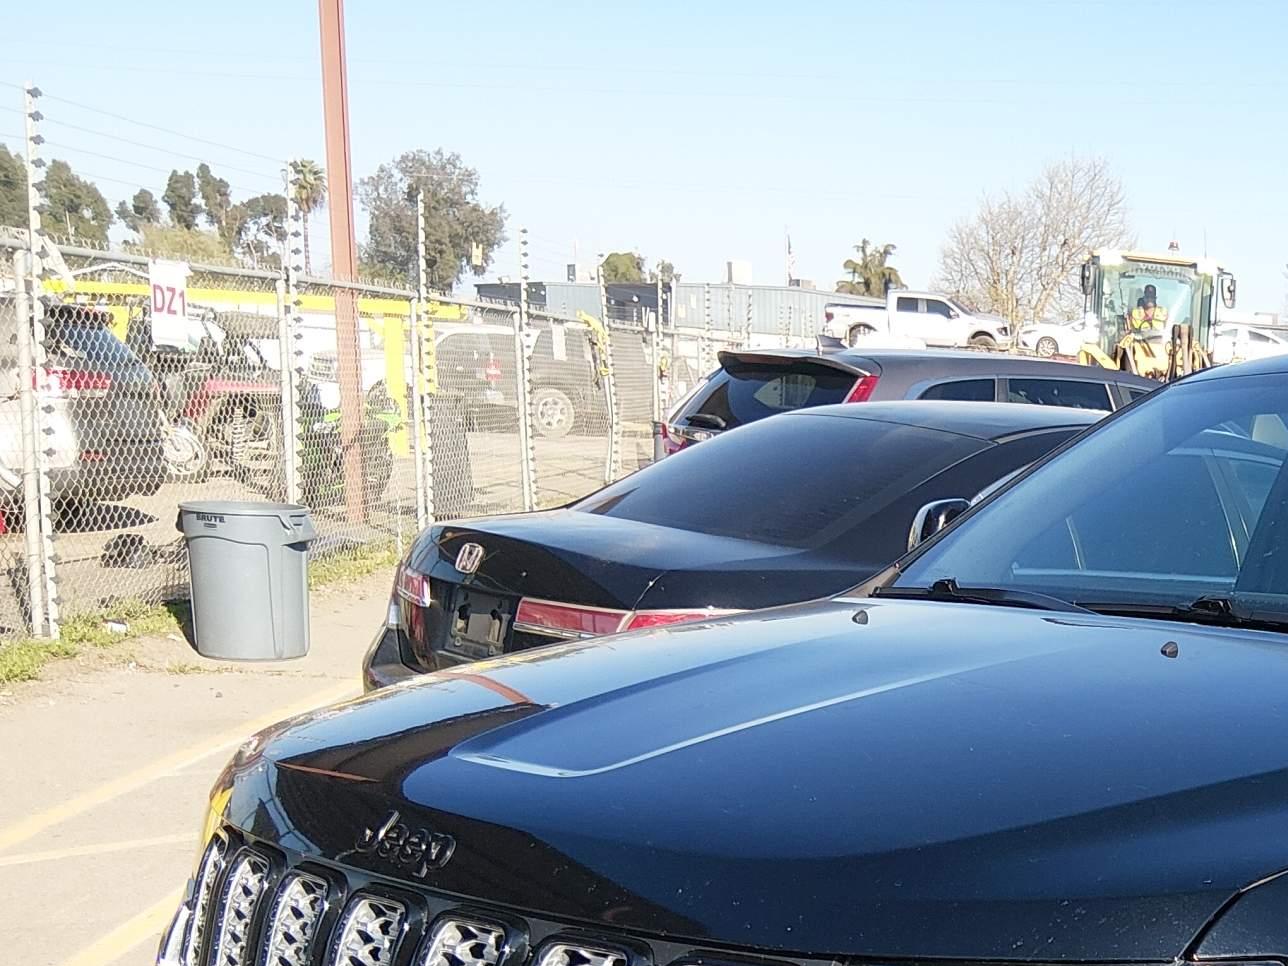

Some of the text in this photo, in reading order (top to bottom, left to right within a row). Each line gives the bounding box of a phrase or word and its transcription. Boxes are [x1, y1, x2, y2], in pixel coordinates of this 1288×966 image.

[153, 284, 186, 317] DZ1
[195, 513, 225, 523] BRUTE
[355, 809, 457, 878] Jeep
